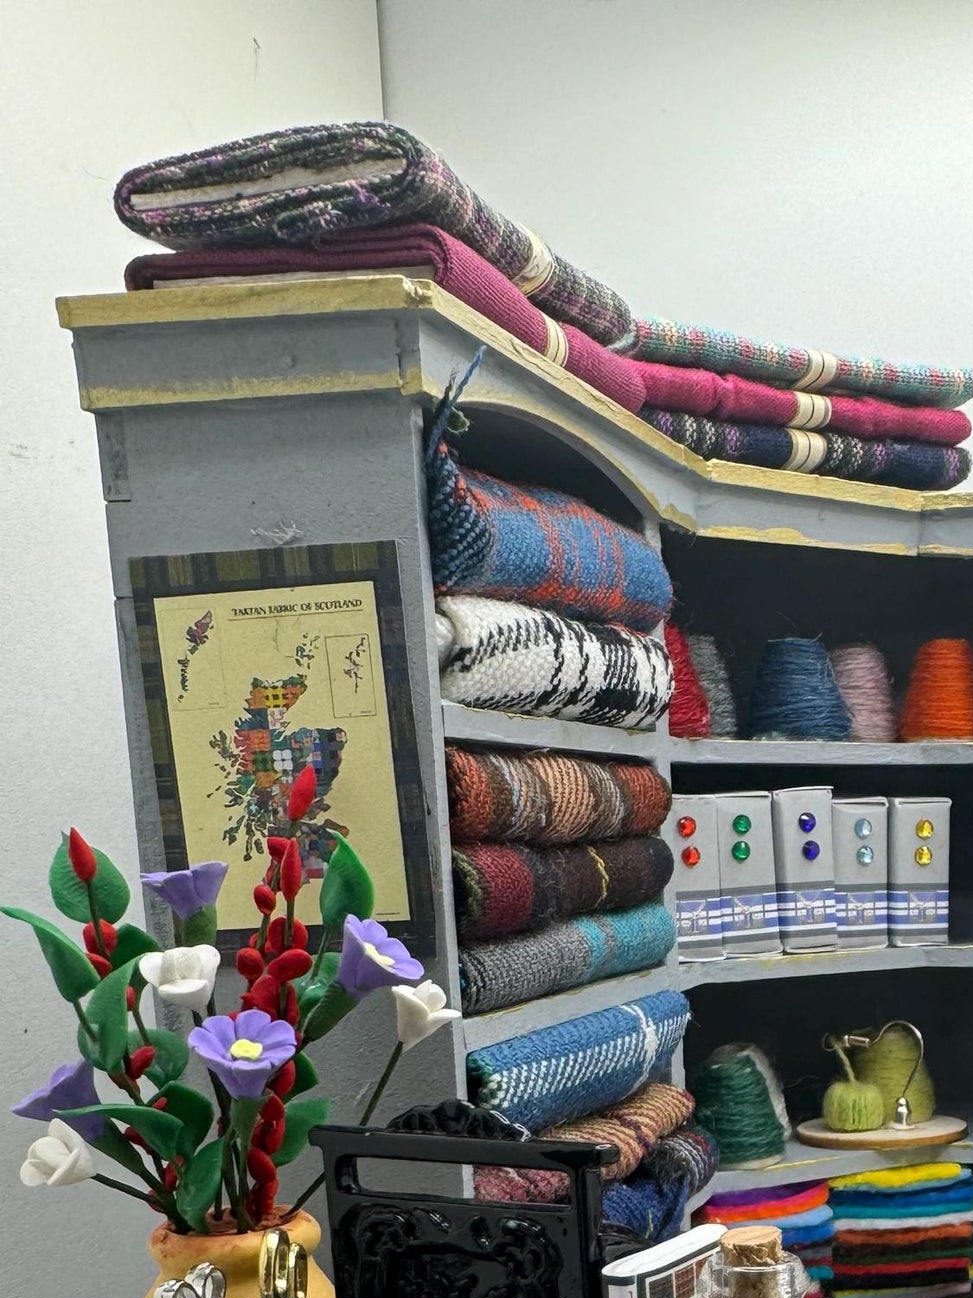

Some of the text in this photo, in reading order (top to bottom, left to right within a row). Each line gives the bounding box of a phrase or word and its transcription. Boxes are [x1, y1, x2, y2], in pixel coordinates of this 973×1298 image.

[231, 598, 363, 617] TARTAN FABRIC OF SCOTLAND
